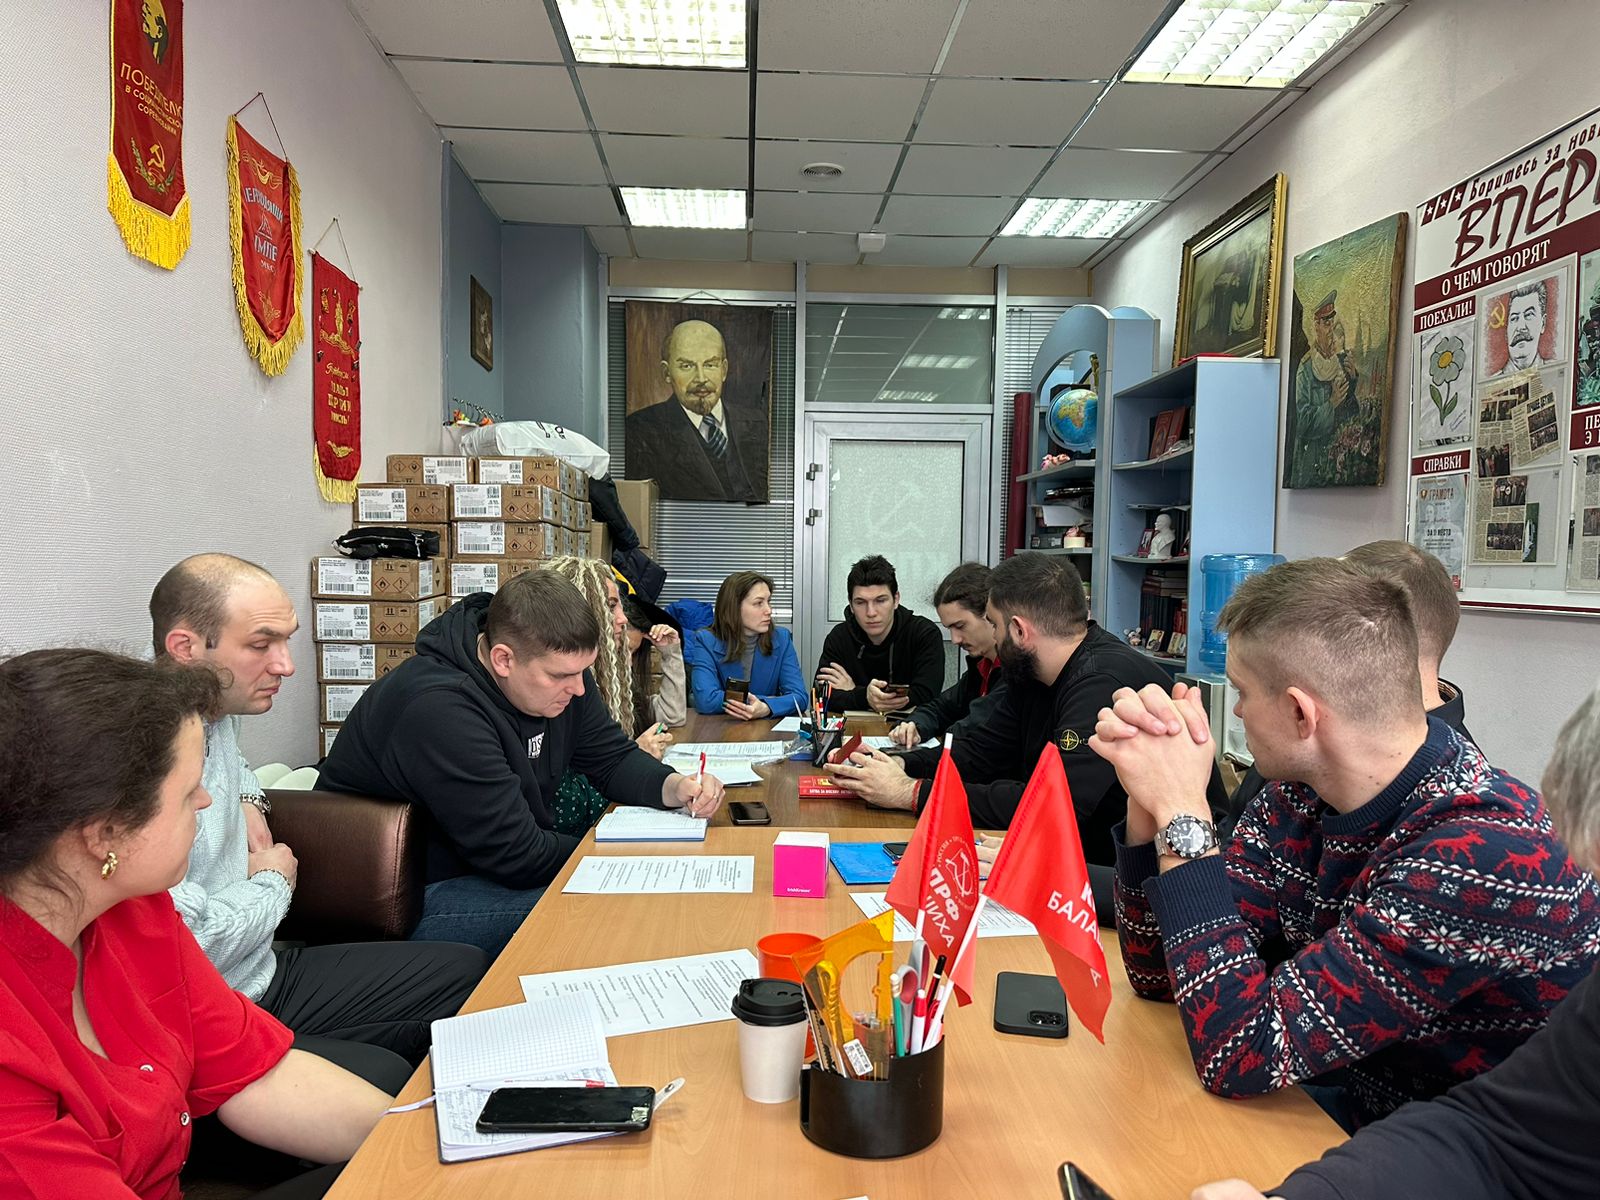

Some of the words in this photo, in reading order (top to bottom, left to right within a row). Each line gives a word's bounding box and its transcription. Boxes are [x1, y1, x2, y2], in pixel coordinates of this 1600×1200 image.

[1469, 157, 1538, 201] Боритесь
[1544, 144, 1561, 165] за
[1441, 278, 1451, 296] О
[1454, 267, 1482, 291] ЧЕМ
[1485, 239, 1551, 281] ГОВОРЯТ
[1419, 300, 1473, 330] ПОЕХАЛИ!
[1423, 454, 1462, 473] СПРАВКИ
[929, 867, 960, 921] ПРФ
